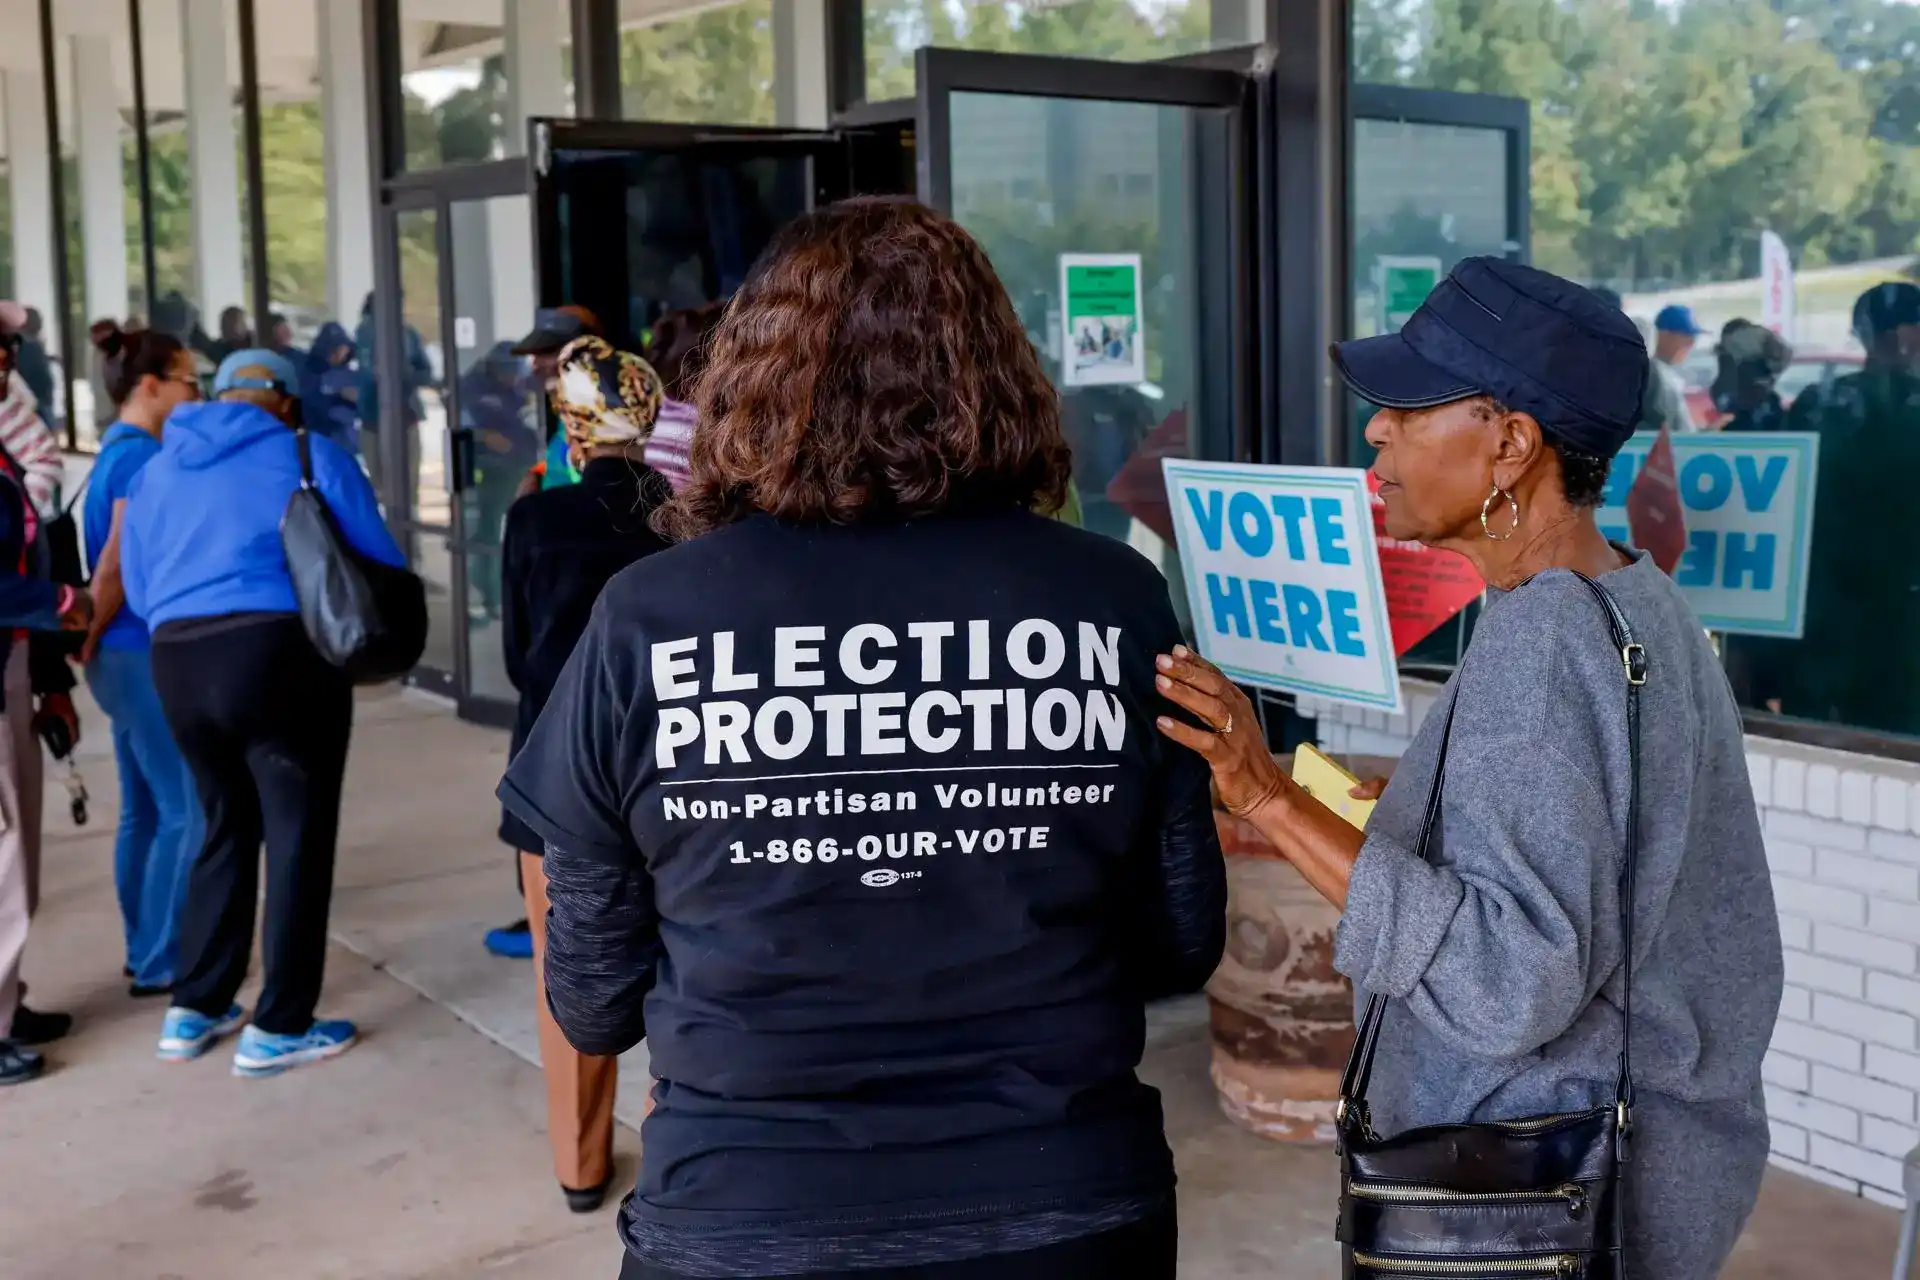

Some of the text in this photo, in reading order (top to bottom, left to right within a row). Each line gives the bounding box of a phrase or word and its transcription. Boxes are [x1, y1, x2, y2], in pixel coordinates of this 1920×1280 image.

[1184, 485, 1352, 567] VOTE
[1204, 571, 1368, 659] HERE
[650, 618, 1122, 702] ELECTION
[655, 687, 1126, 769] PROTECTION
[662, 781, 1115, 821] Non-Partisan Volunteer
[729, 826, 1050, 864] 1-866-OUR-VOTE
